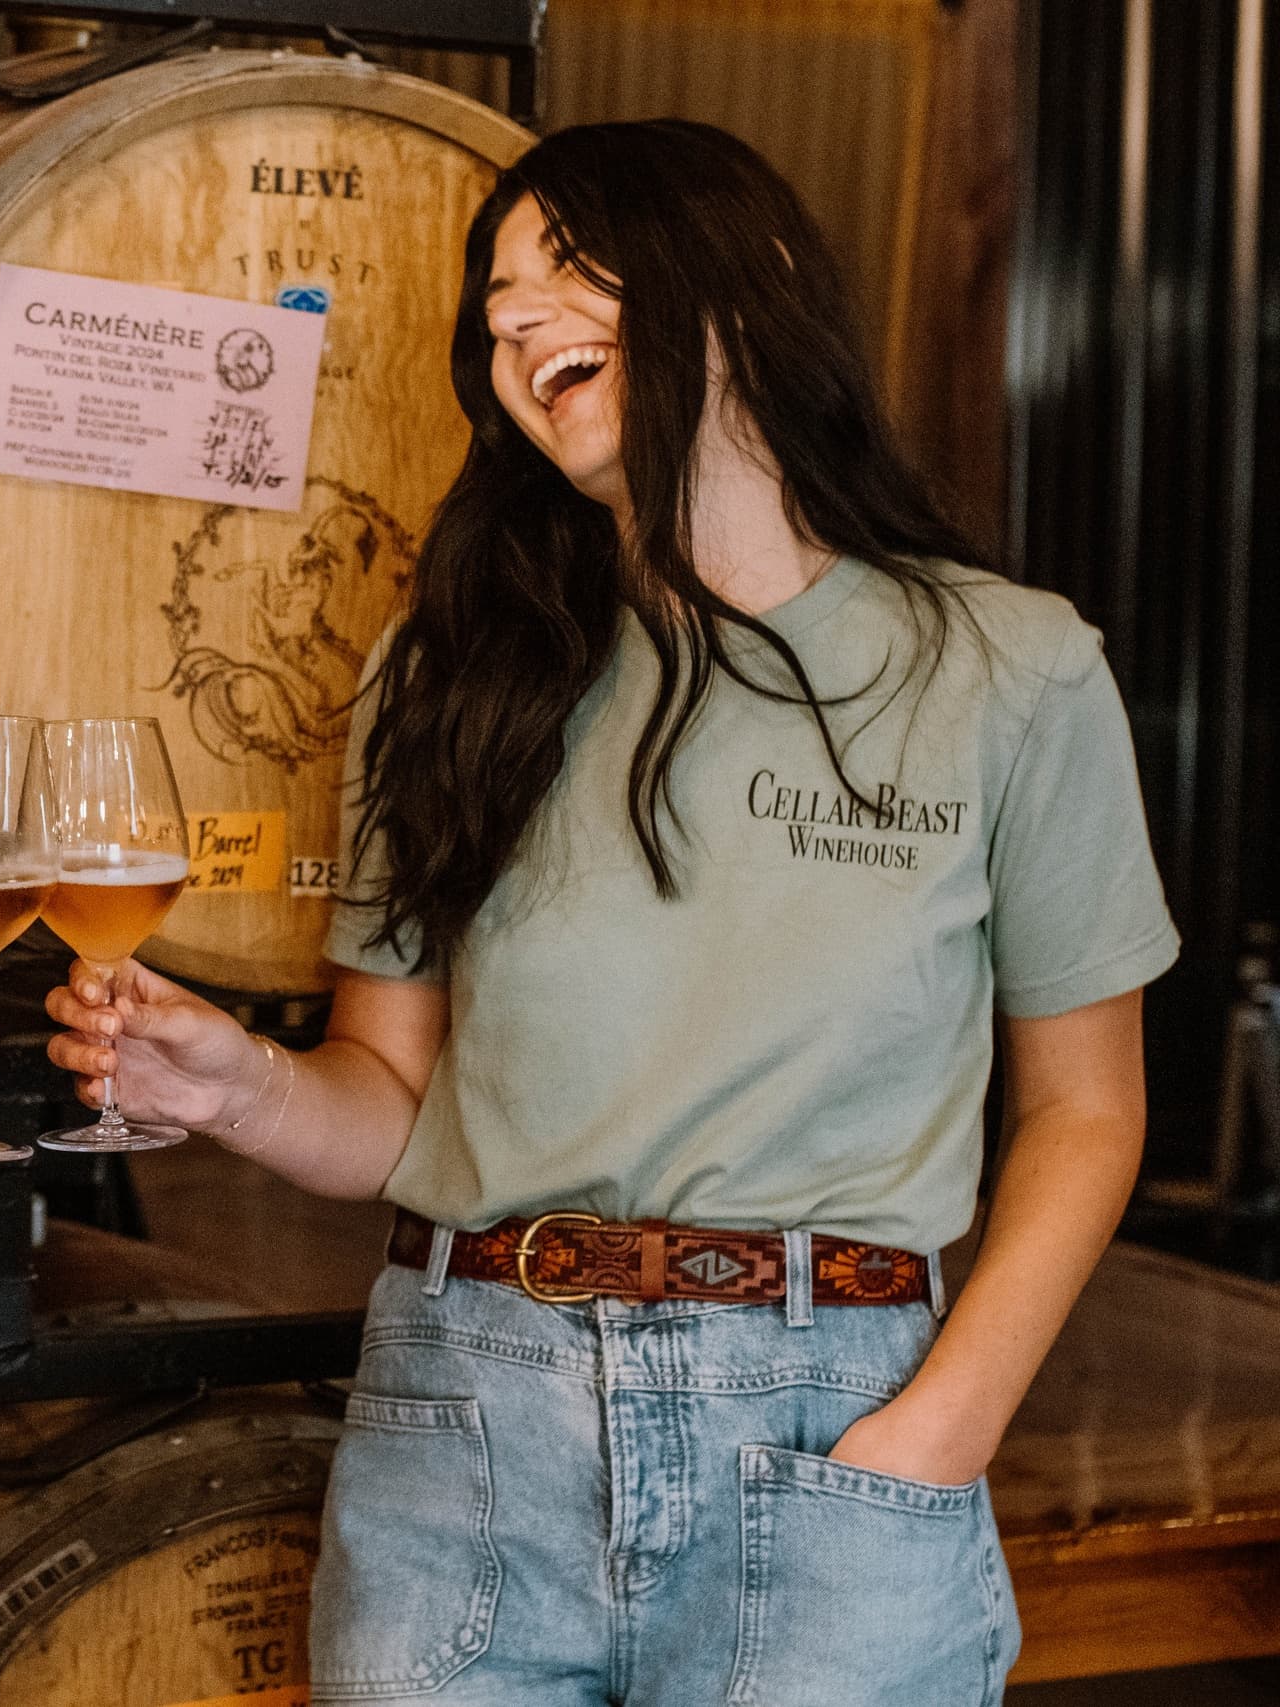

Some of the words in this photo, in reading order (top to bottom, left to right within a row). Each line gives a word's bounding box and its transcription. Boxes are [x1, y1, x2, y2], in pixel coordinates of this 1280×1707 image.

[250, 157, 364, 200] ÉLEVÉ
[233, 247, 377, 285] TRUST
[23, 302, 206, 350] CARMÉNÈRE
[57, 334, 123, 356] VINTAGE
[127, 344, 165, 360] 2024
[43, 364, 95, 382] YAKIMA
[152, 380, 176, 393] WA
[68, 353, 94, 367] DEL
[138, 362, 208, 383] VINEYARD
[747, 768, 864, 830] CELLAR
[874, 781, 968, 836] BEAST
[193, 816, 262, 862] Barrel
[787, 824, 920, 871] WINEHOUSE
[225, 1610, 289, 1634] FRANCE
[232, 1640, 288, 1680] TG
